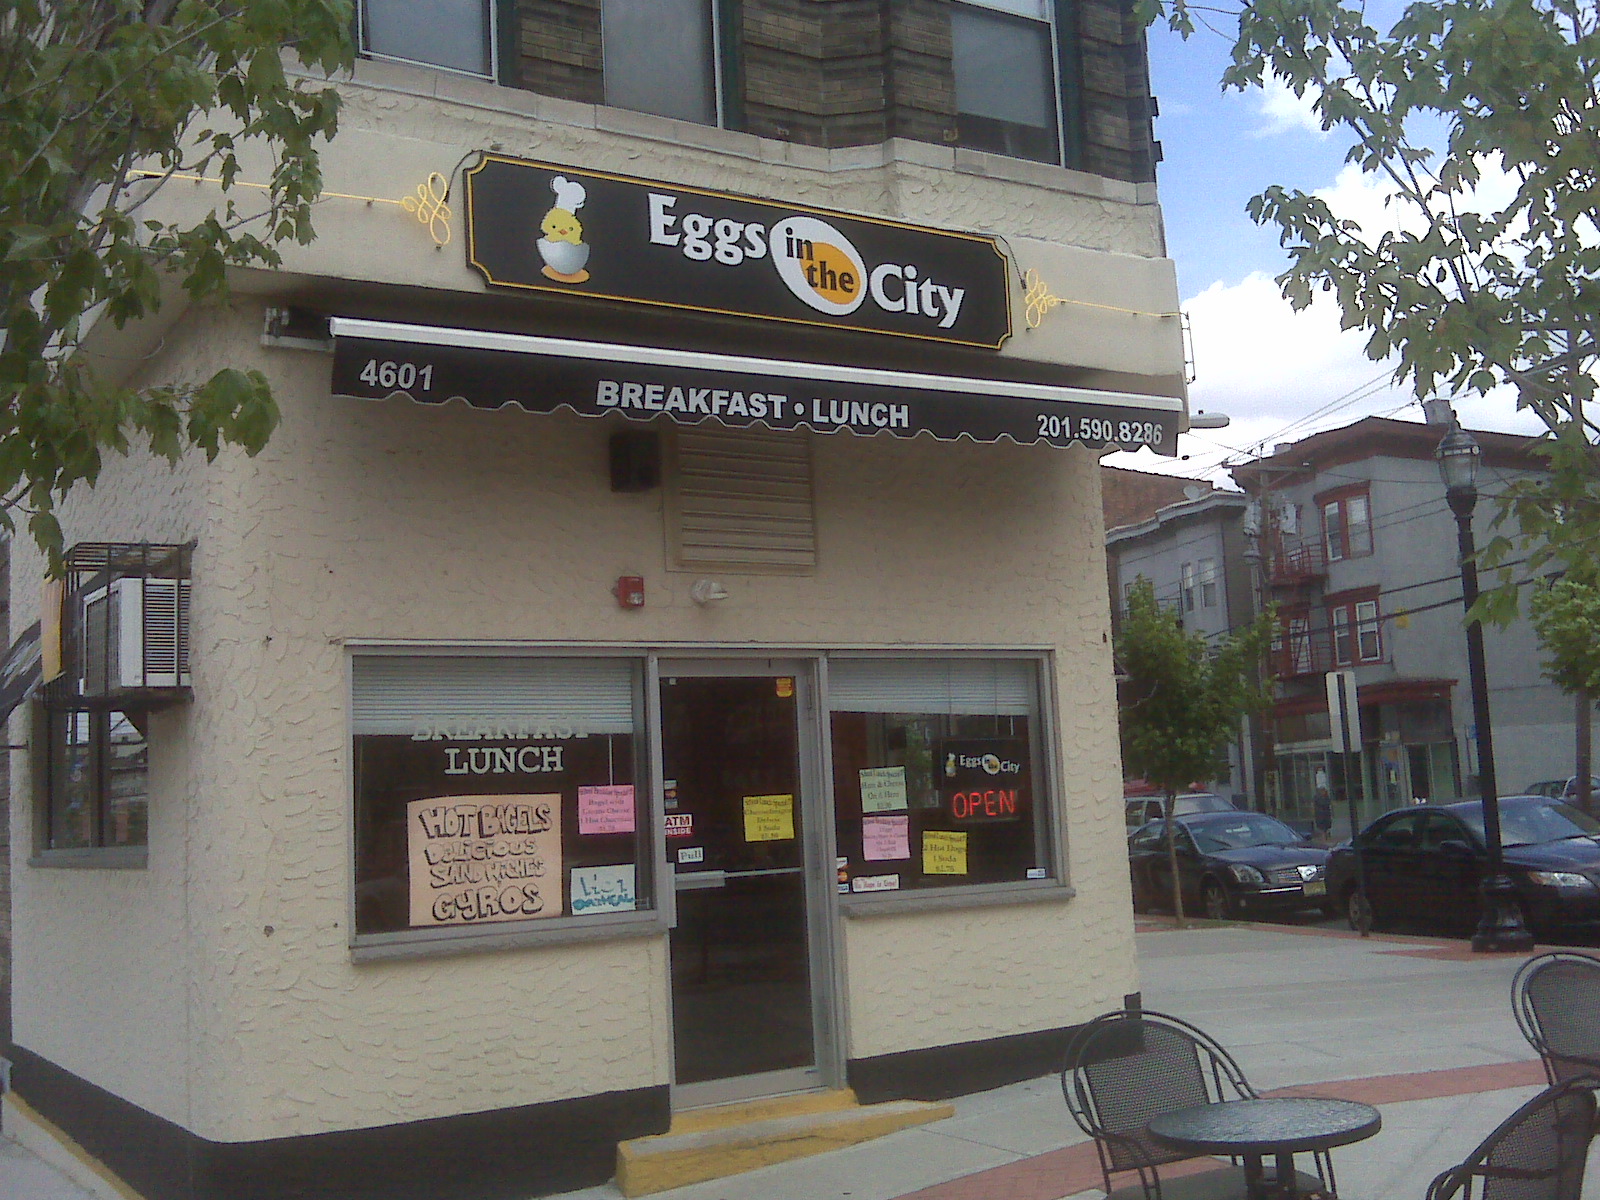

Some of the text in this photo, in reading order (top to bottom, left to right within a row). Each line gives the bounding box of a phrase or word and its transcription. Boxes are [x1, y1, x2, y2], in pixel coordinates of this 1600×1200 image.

[647, 192, 965, 329] Eggs in the City
[359, 359, 434, 391] 4601
[596, 380, 910, 429] BREAKFAST LUNCH
[1036, 414, 1163, 446] 201.590.8286
[444, 745, 564, 775] LUNCH
[959, 754, 981, 768] Eggs
[1000, 760, 1021, 774] City
[953, 789, 1016, 818] OPEN
[418, 803, 552, 839] HOT BAGELS
[665, 815, 690, 827] ATM
[665, 827, 692, 836] INSIDE
[424, 838, 538, 866] DELICIOUS
[680, 849, 702, 860] Pull
[432, 883, 544, 921] GYROS
